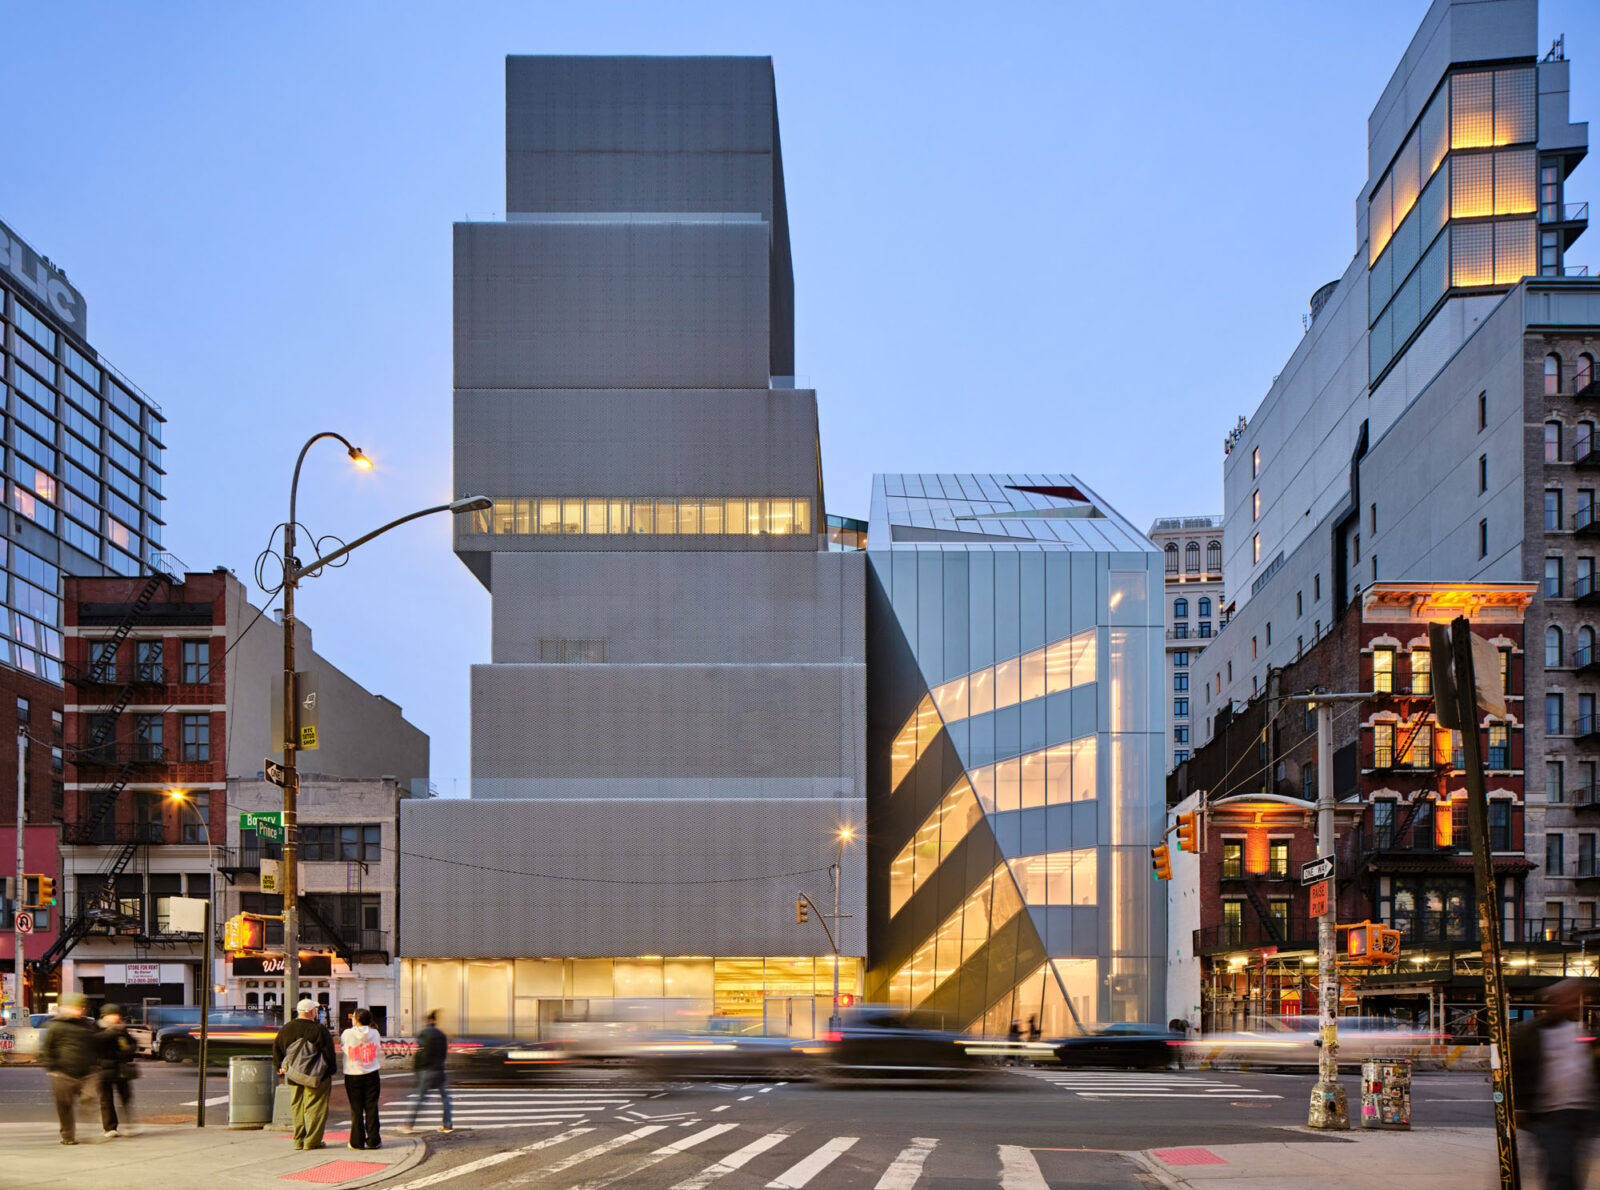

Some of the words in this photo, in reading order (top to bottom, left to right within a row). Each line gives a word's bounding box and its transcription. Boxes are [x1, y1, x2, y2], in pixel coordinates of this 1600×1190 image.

[259, 821, 277, 839] Prince
[1304, 867, 1314, 878] ONE
[1318, 863, 1328, 873] WAY
[1312, 885, 1325, 898] RAISE
